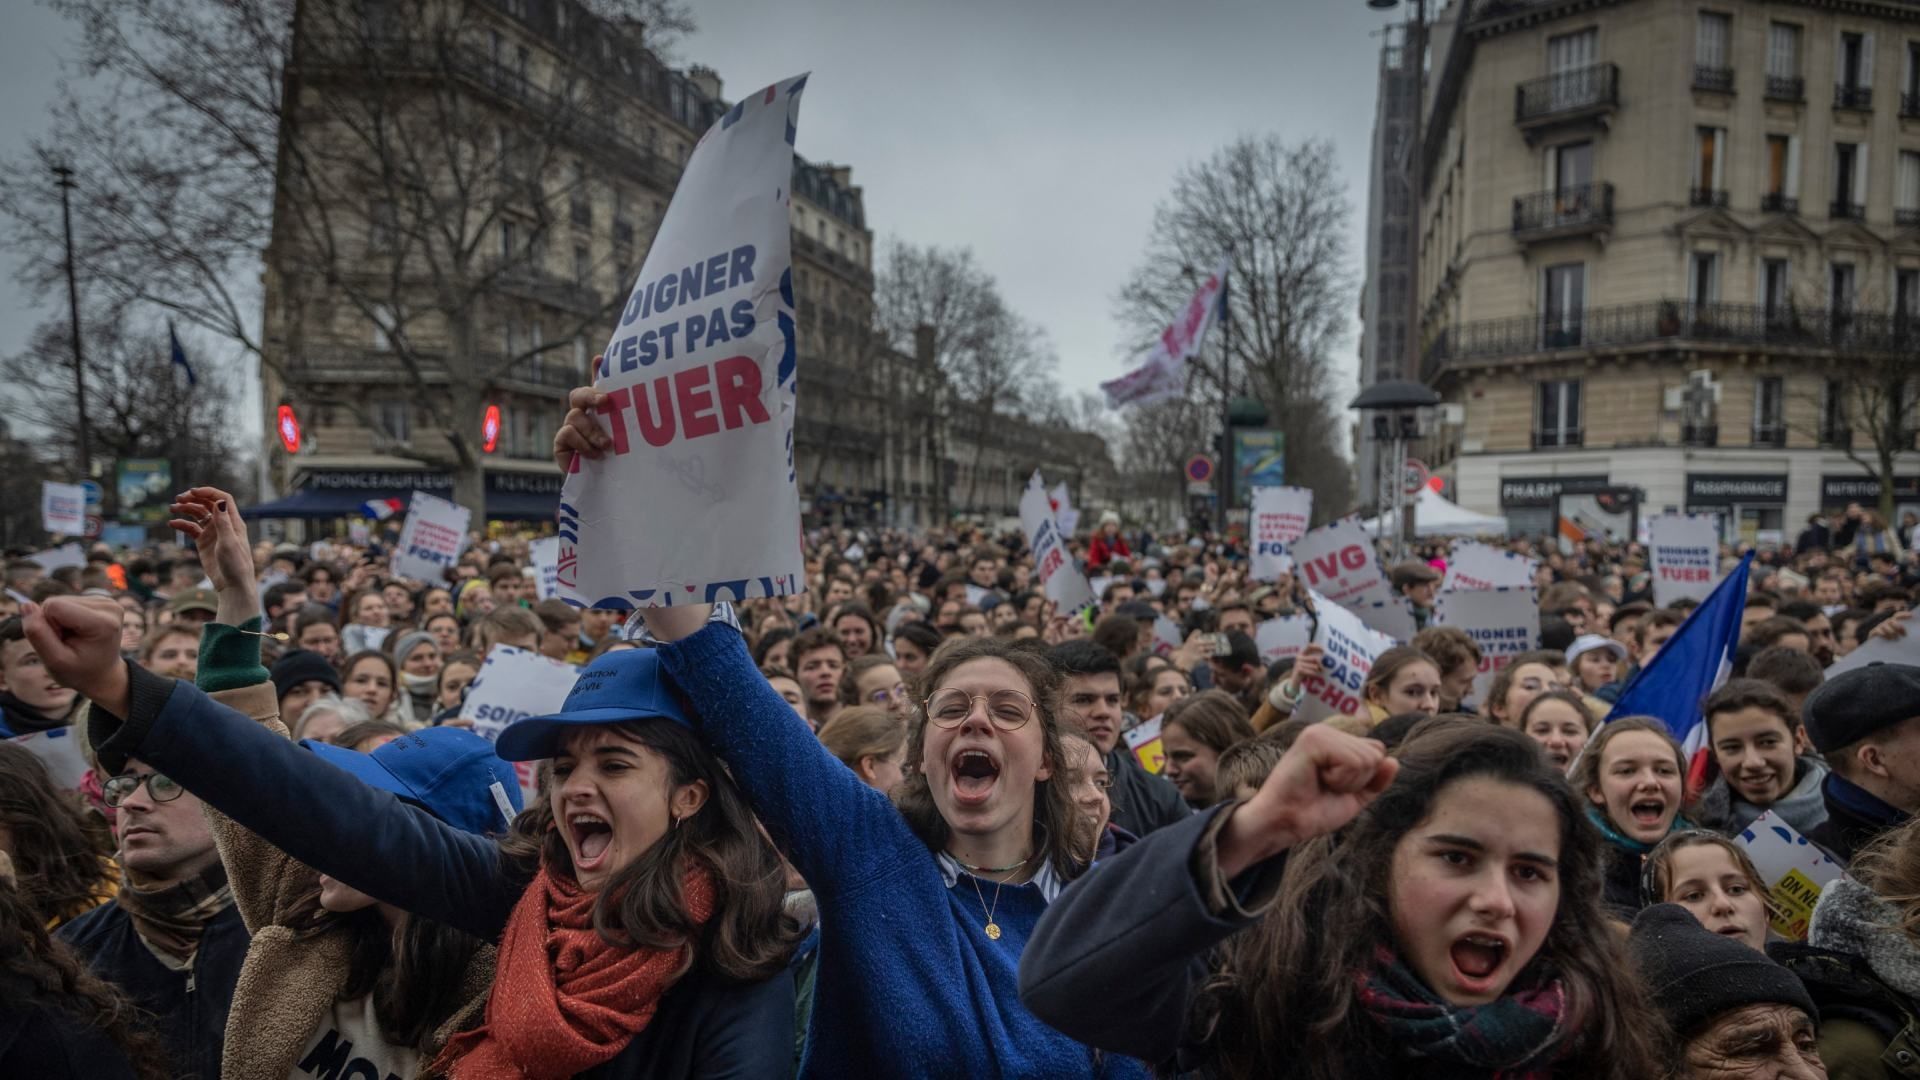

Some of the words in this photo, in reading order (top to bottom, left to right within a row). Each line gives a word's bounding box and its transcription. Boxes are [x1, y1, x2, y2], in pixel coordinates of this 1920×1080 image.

[622, 244, 757, 327] OIGNER
[685, 299, 756, 354] PAS
[598, 355, 771, 456] TUER
[1303, 544, 1367, 585] IVG
[1659, 566, 1711, 583] TUER
[1327, 637, 1348, 660] UN
[1466, 627, 1527, 640] OIGNER
[1498, 641, 1528, 652] PAS
[1476, 655, 1509, 674] UE
[1303, 675, 1359, 716] CHO
[1781, 875, 1804, 896] ON
[297, 1028, 403, 1080] MO
